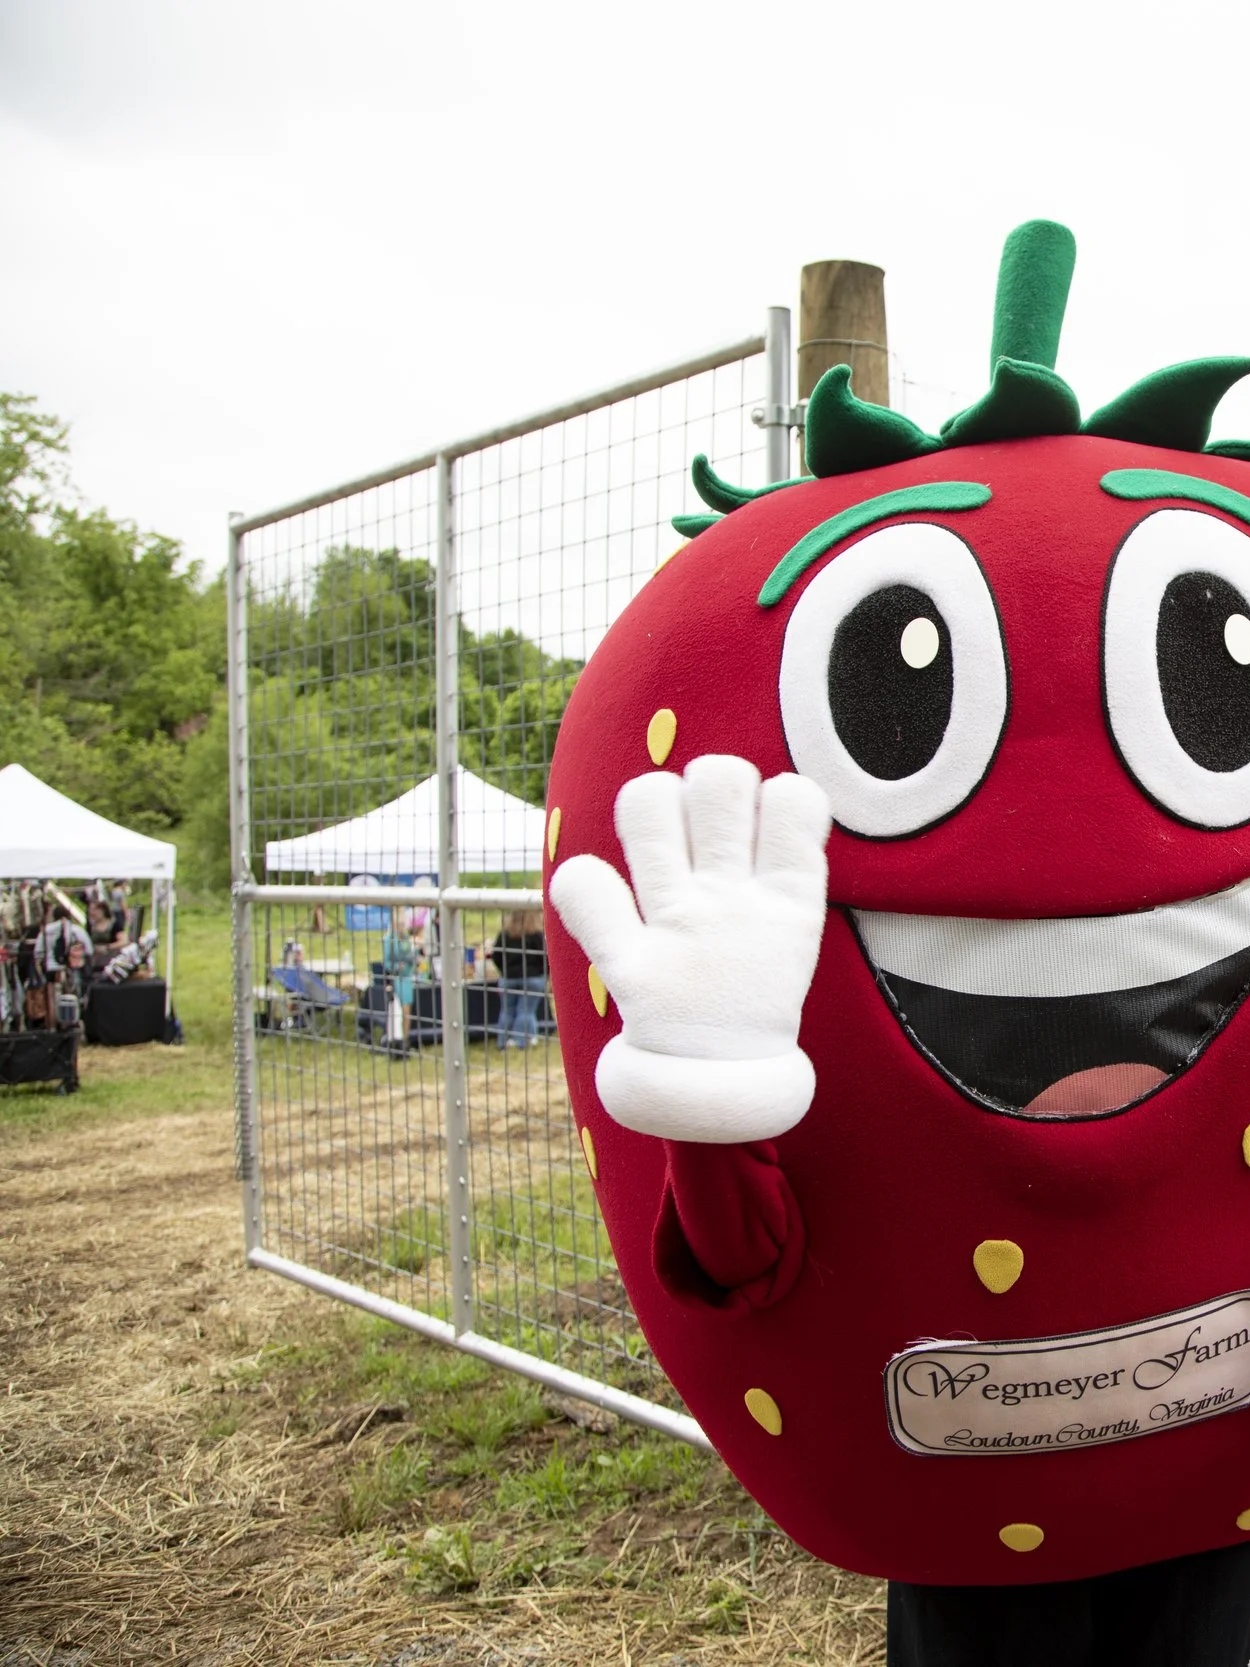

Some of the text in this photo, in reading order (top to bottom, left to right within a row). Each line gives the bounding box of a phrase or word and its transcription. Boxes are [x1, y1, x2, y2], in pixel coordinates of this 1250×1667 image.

[903, 1360, 1126, 1406] Wegmeyer
[944, 1386, 1235, 1449] Loudoun County, Virginia
